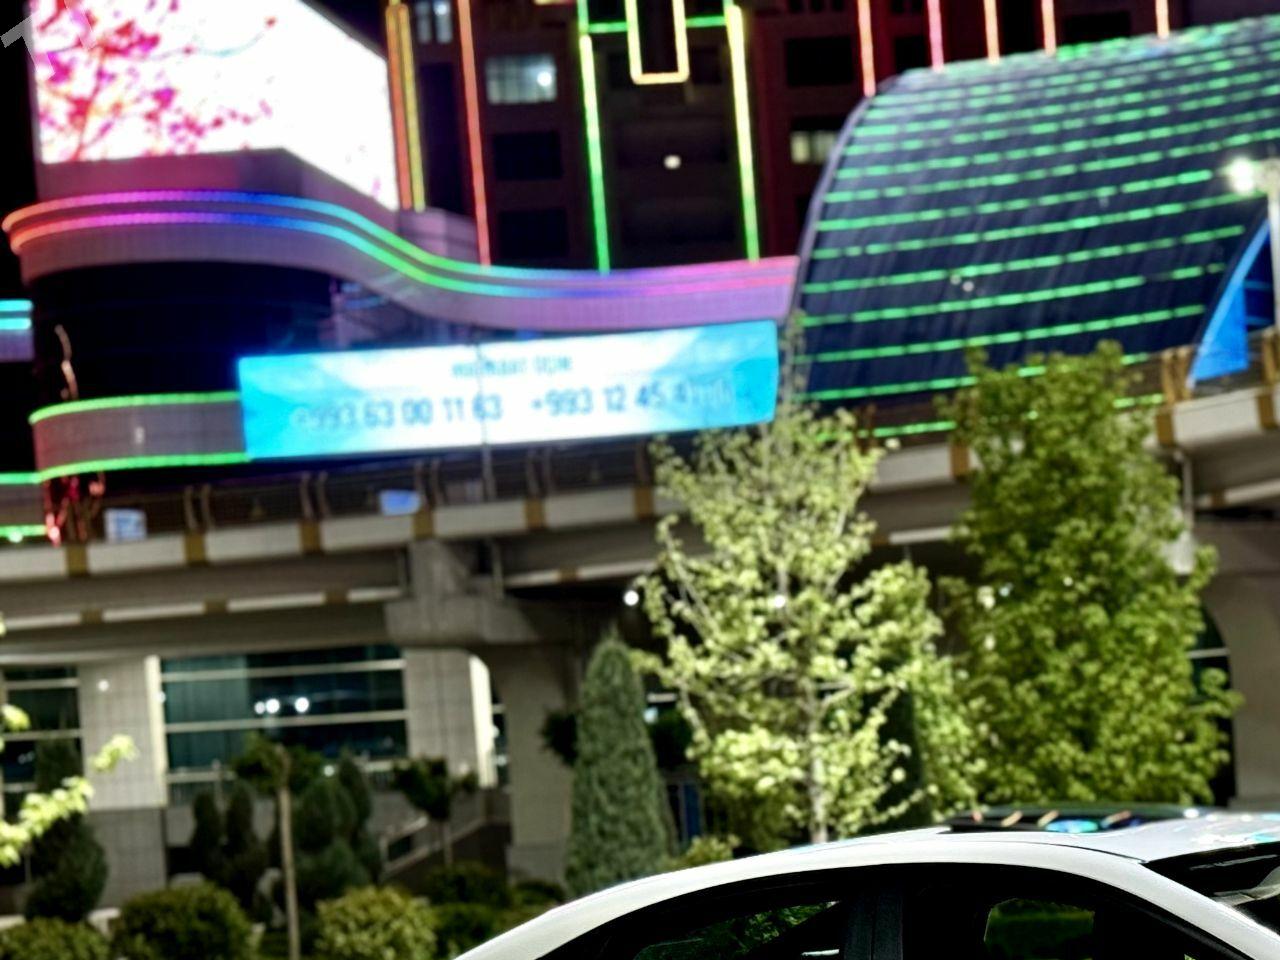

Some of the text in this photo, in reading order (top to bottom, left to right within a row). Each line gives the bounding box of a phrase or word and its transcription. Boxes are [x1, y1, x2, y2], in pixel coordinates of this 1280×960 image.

[364, 398, 395, 428] 63
[401, 398, 434, 427] 00
[442, 397, 465, 423] 11
[531, 386, 594, 416] +993
[604, 383, 627, 413] 12
